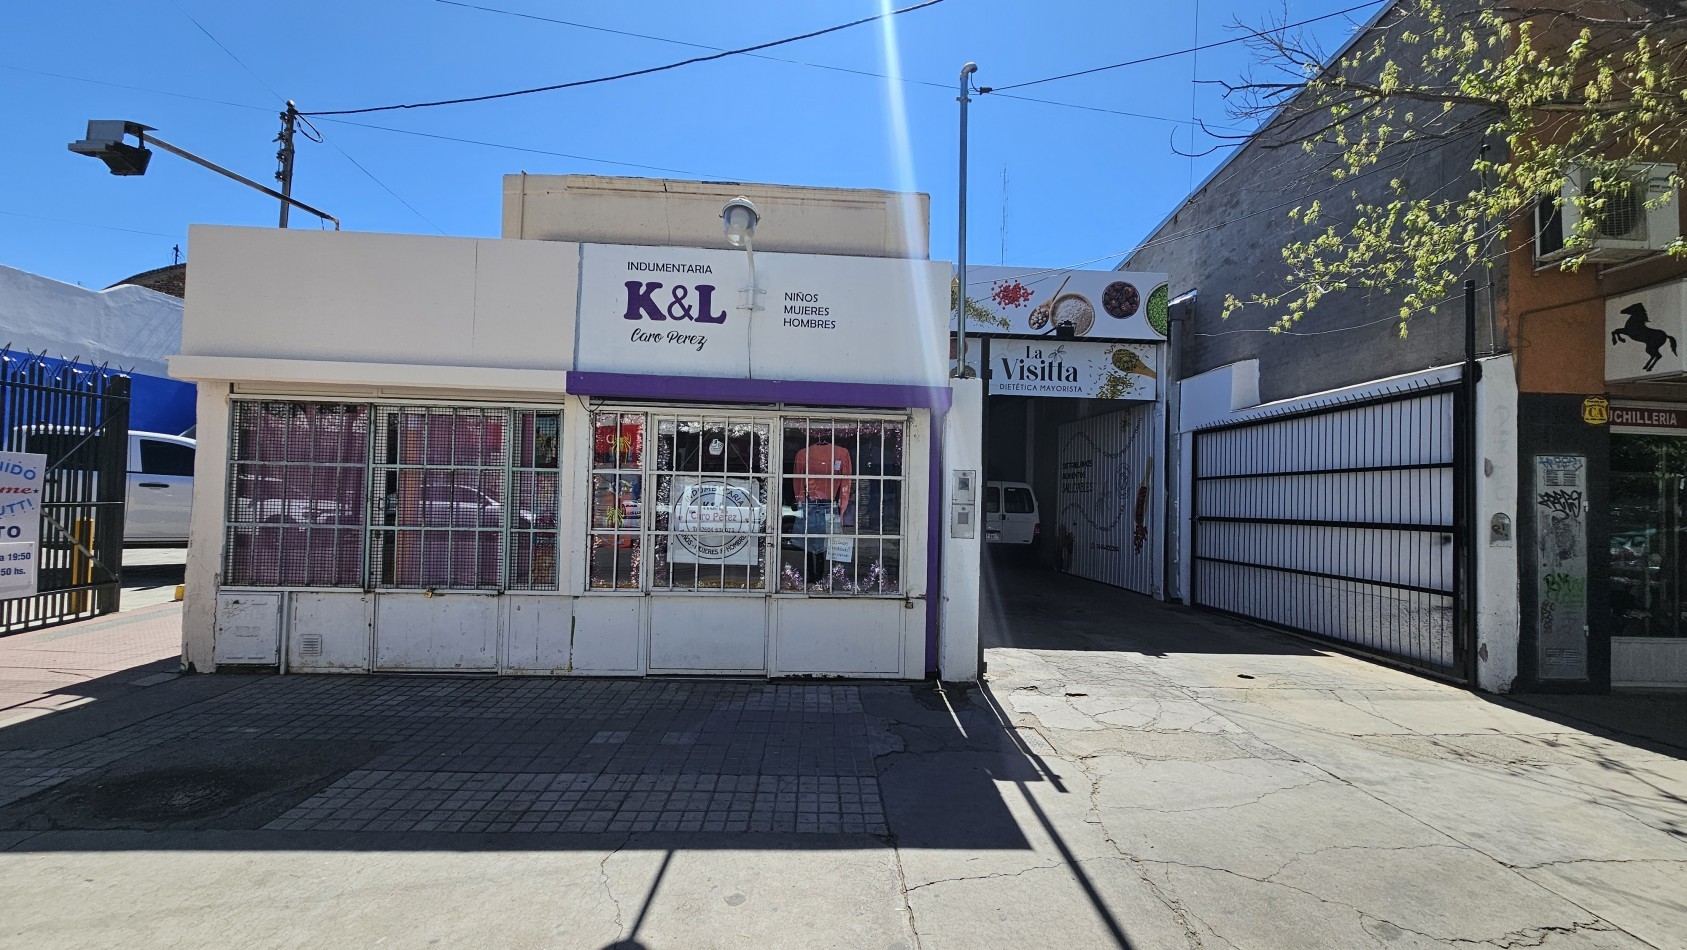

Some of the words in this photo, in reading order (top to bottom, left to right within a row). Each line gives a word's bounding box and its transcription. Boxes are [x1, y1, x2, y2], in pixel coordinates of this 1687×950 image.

[627, 261, 713, 274] INDUMENTARIA
[623, 280, 727, 325] K&L
[784, 291, 819, 303] NIÑOS
[784, 305, 830, 316] MUJERES
[783, 318, 836, 329] HOMBRES
[630, 328, 663, 344] Caro
[666, 330, 708, 351] Perez
[1026, 345, 1042, 359] La
[1001, 357, 1078, 382] Visitta
[999, 383, 1038, 391] DIETÉTICA
[1040, 385, 1083, 393] MAYORISTA
[1609, 410, 1678, 425] CHILLERIA
[8, 552, 31, 561] 19:50
